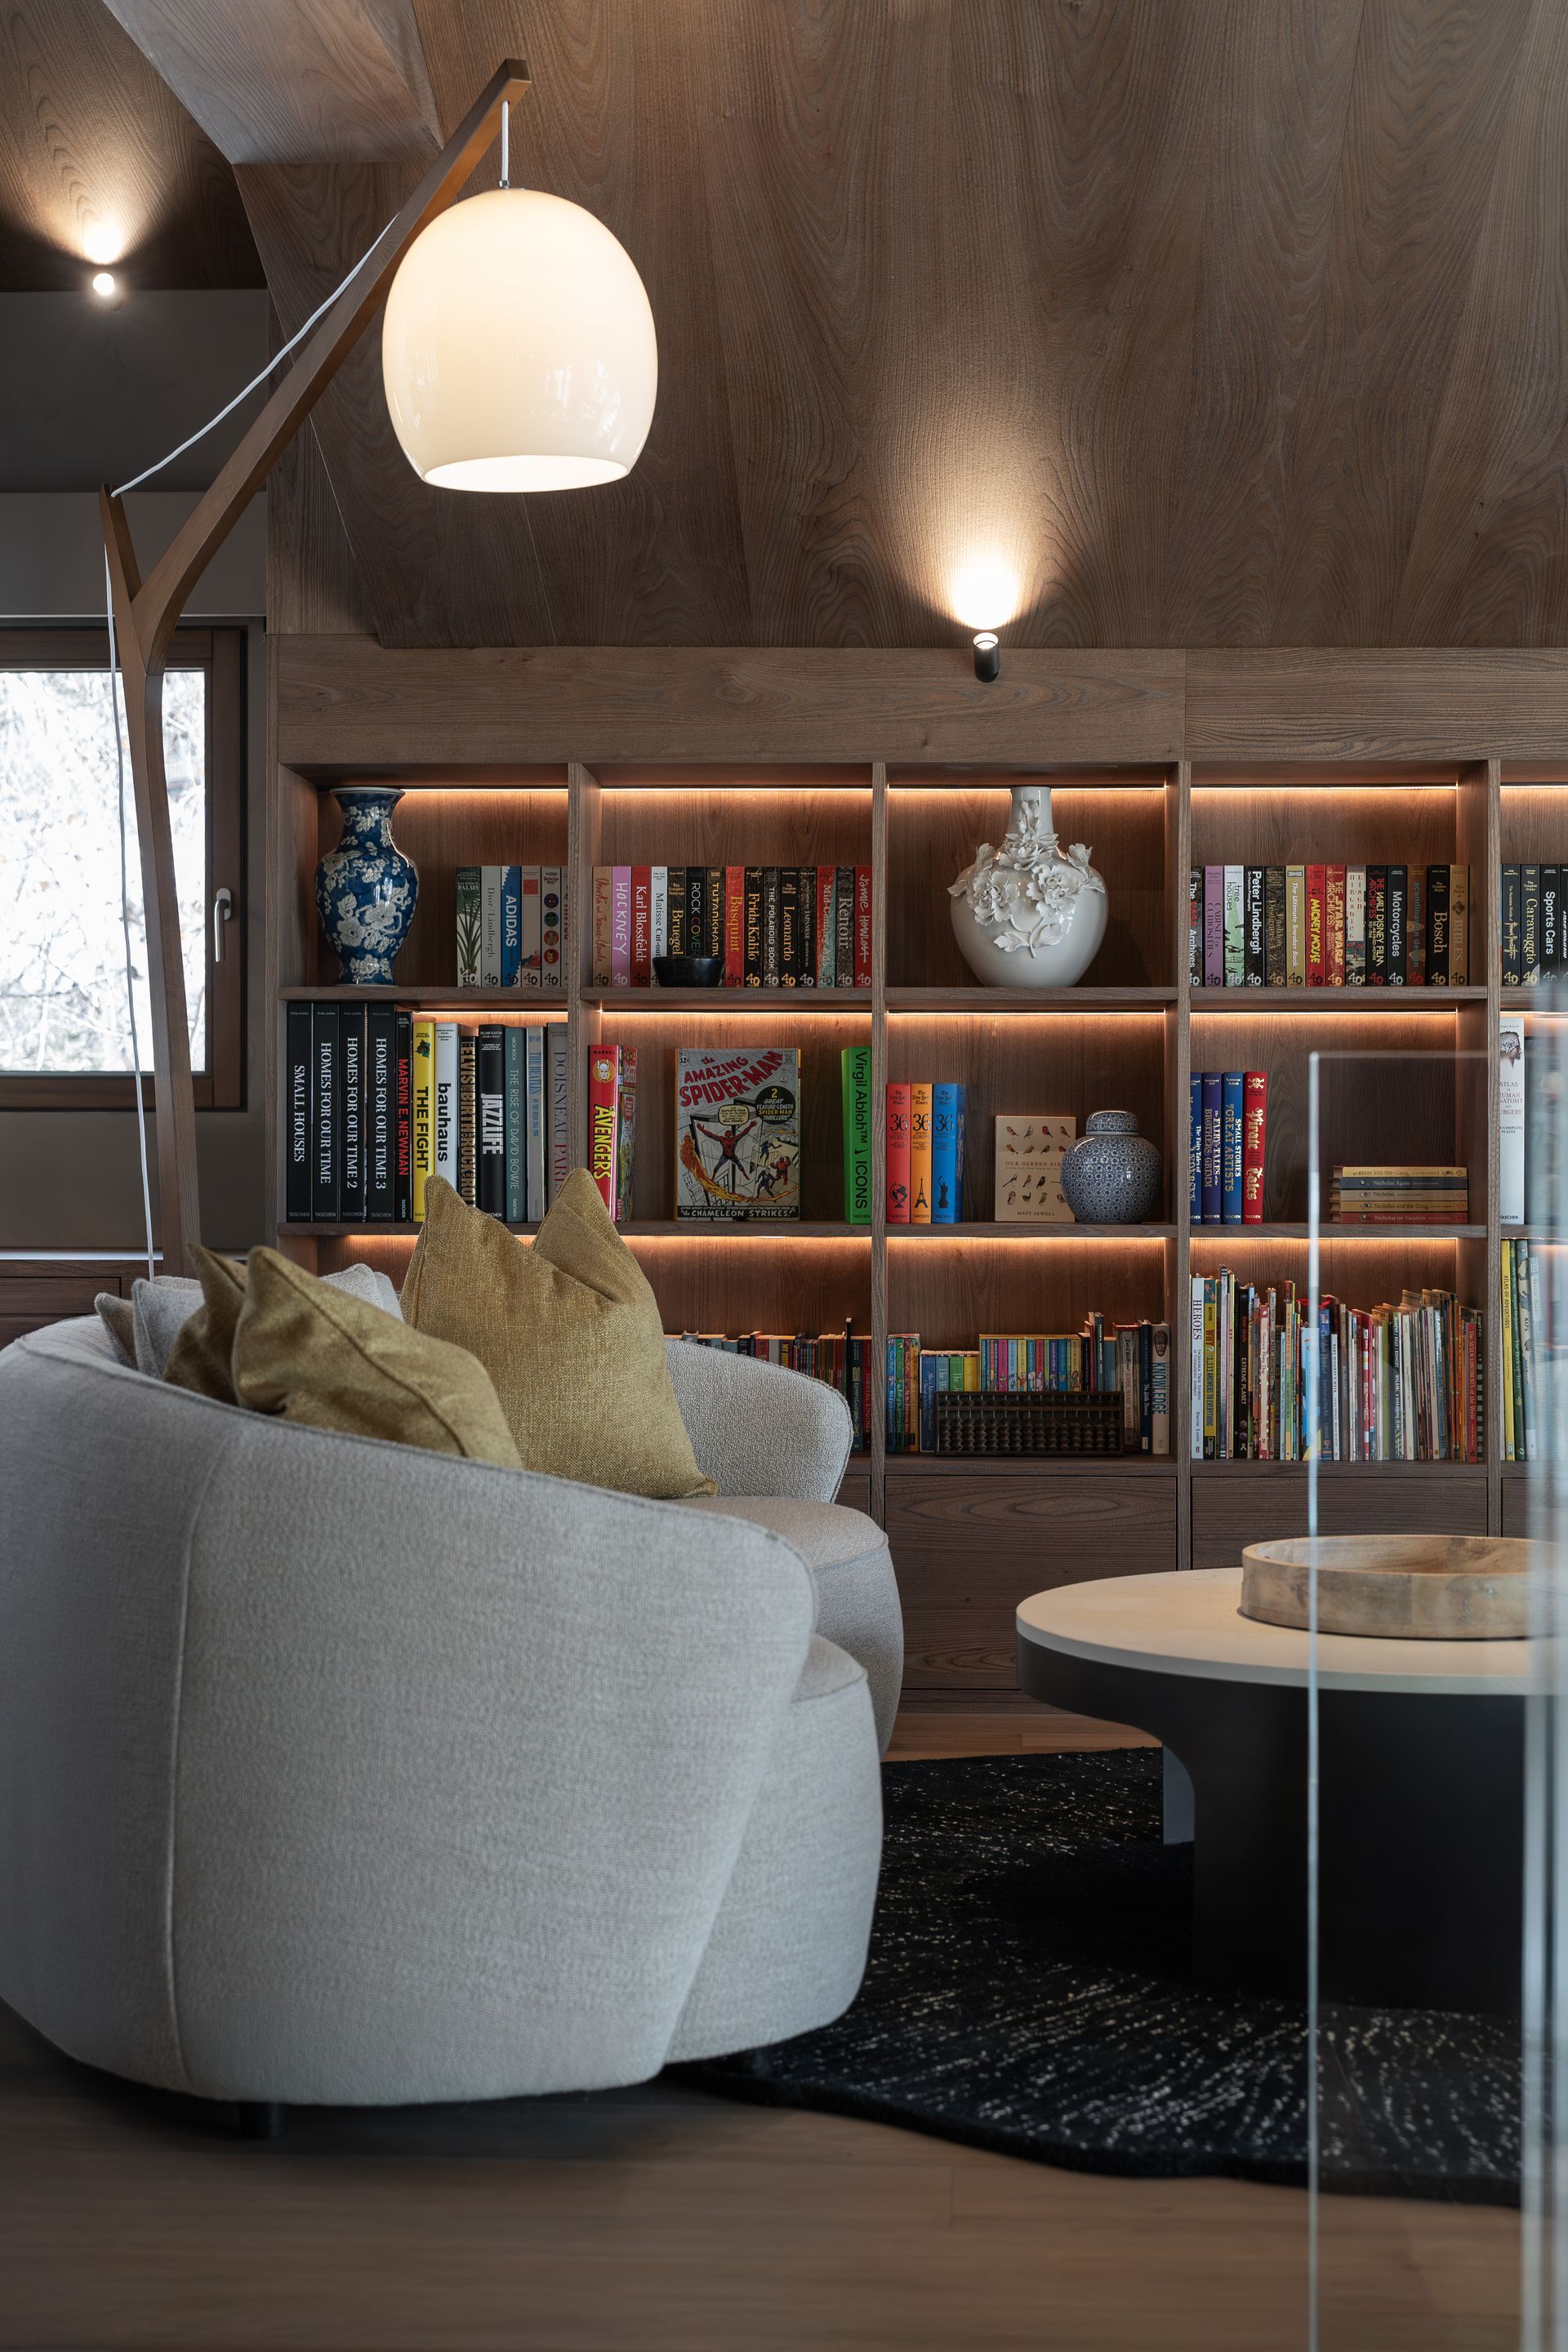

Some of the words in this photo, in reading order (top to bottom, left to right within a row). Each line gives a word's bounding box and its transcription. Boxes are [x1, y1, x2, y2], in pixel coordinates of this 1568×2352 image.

[636, 886, 647, 908] Karl
[691, 882, 701, 914] ROCK
[1227, 882, 1236, 911] houses
[1250, 871, 1263, 900] Peter
[1334, 880, 1343, 894] THE
[1369, 877, 1377, 918] ARCHIVES
[1377, 877, 1385, 890] THE
[655, 893, 665, 926] Matisse
[748, 892, 761, 923] Frida
[1310, 898, 1321, 933] MICKEY
[1326, 880, 1335, 924] ARCHIVES
[1334, 895, 1343, 930] STAR
[1377, 892, 1385, 911] WALT
[1544, 891, 1556, 928] Sports
[506, 895, 517, 947] ADIDAS
[612, 883, 628, 956] HOCKNEY
[669, 908, 684, 956] Bruegel
[728, 896, 743, 951] Basquiat
[783, 906, 795, 961] Leonardo
[838, 897, 853, 949] Renoir
[1250, 902, 1263, 954] Lindbergh
[1276, 914, 1284, 947] Fashion
[1377, 915, 1385, 942] DISNEY
[1390, 891, 1403, 957] Motorcycles
[1433, 911, 1448, 954] Bosch
[1522, 898, 1538, 964] Caravaggio
[635, 912, 648, 963] Blossfeldt
[655, 928, 663, 958] Cut-out
[691, 916, 701, 957] COVER
[748, 926, 761, 961] Kahlo
[1310, 934, 1321, 964] MOUSE
[1334, 929, 1343, 965] WARS
[1454, 920, 1463, 960] BIBLES
[1545, 929, 1556, 954] Cars
[1377, 946, 1385, 967] FILM
[746, 973, 761, 985] 40
[764, 973, 779, 985] 40
[781, 973, 797, 985] 40
[800, 973, 814, 985] 40
[857, 973, 871, 985] 40
[1247, 972, 1263, 985] 40
[1328, 972, 1343, 985] 40
[1348, 972, 1362, 985] 40
[1388, 972, 1403, 985] 40
[320, 1042, 332, 1088] HOMES
[346, 1037, 358, 1084] HOMES
[376, 1037, 387, 1085] HOMES
[461, 1047, 475, 1085] ELVIS
[529, 1052, 542, 1065] THE
[684, 1056, 750, 1085] AMAZING
[853, 1052, 867, 1086] Virgil
[294, 1065, 305, 1108] SMALL
[399, 1058, 408, 1104] MARVIN
[510, 1069, 519, 1085] THE
[529, 1067, 542, 1094] BEATLES
[679, 1050, 784, 1107] SPIDER-MAN
[771, 1088, 778, 1099] 2
[320, 1091, 332, 1117] FOR
[346, 1086, 358, 1111] FOR
[376, 1087, 387, 1112] FOR
[416, 1086, 428, 1119] THE
[510, 1089, 519, 1107] RISE
[555, 1052, 568, 1140] DOISNEAU
[346, 1115, 358, 1142] OUR
[376, 1116, 387, 1143] OUR
[399, 1107, 408, 1119] E.
[438, 1083, 451, 1161] bauhaus
[461, 1094, 475, 1132] BIRTH
[480, 1093, 504, 1155] JAZZLIFE
[510, 1111, 519, 1125] OF
[889, 1114, 908, 1132] 36
[912, 1114, 931, 1132] 36
[936, 1114, 954, 1132] 36
[1246, 1107, 1264, 1150] Pirate
[294, 1111, 305, 1161] HOUSES
[320, 1120, 332, 1148] OUR
[399, 1120, 408, 1176] NEWMAN
[416, 1122, 428, 1171] FIGHT
[510, 1129, 519, 1155] DAVID
[593, 1103, 614, 1180] AVENGERS
[320, 1151, 332, 1184] TIME
[346, 1145, 358, 1178] TIME
[376, 1145, 387, 1178] TIME
[461, 1139, 475, 1173] ROCK
[555, 1143, 568, 1193] PARIS
[346, 1181, 358, 1189] 2
[510, 1158, 519, 1189] BOWIE
[856, 1160, 867, 1209] ICONS
[1246, 1167, 1264, 1200] Tales
[461, 1178, 475, 1207] ROL
[1193, 1299, 1202, 1339] HEROES
[1205, 1330, 1215, 1352] WHY?
[1125, 1374, 1134, 1388] CODE
[1125, 1390, 1134, 1404] NAME
[1152, 1362, 1166, 1414] KNOWLEDGE
[1125, 1406, 1134, 1431] BANANAS
